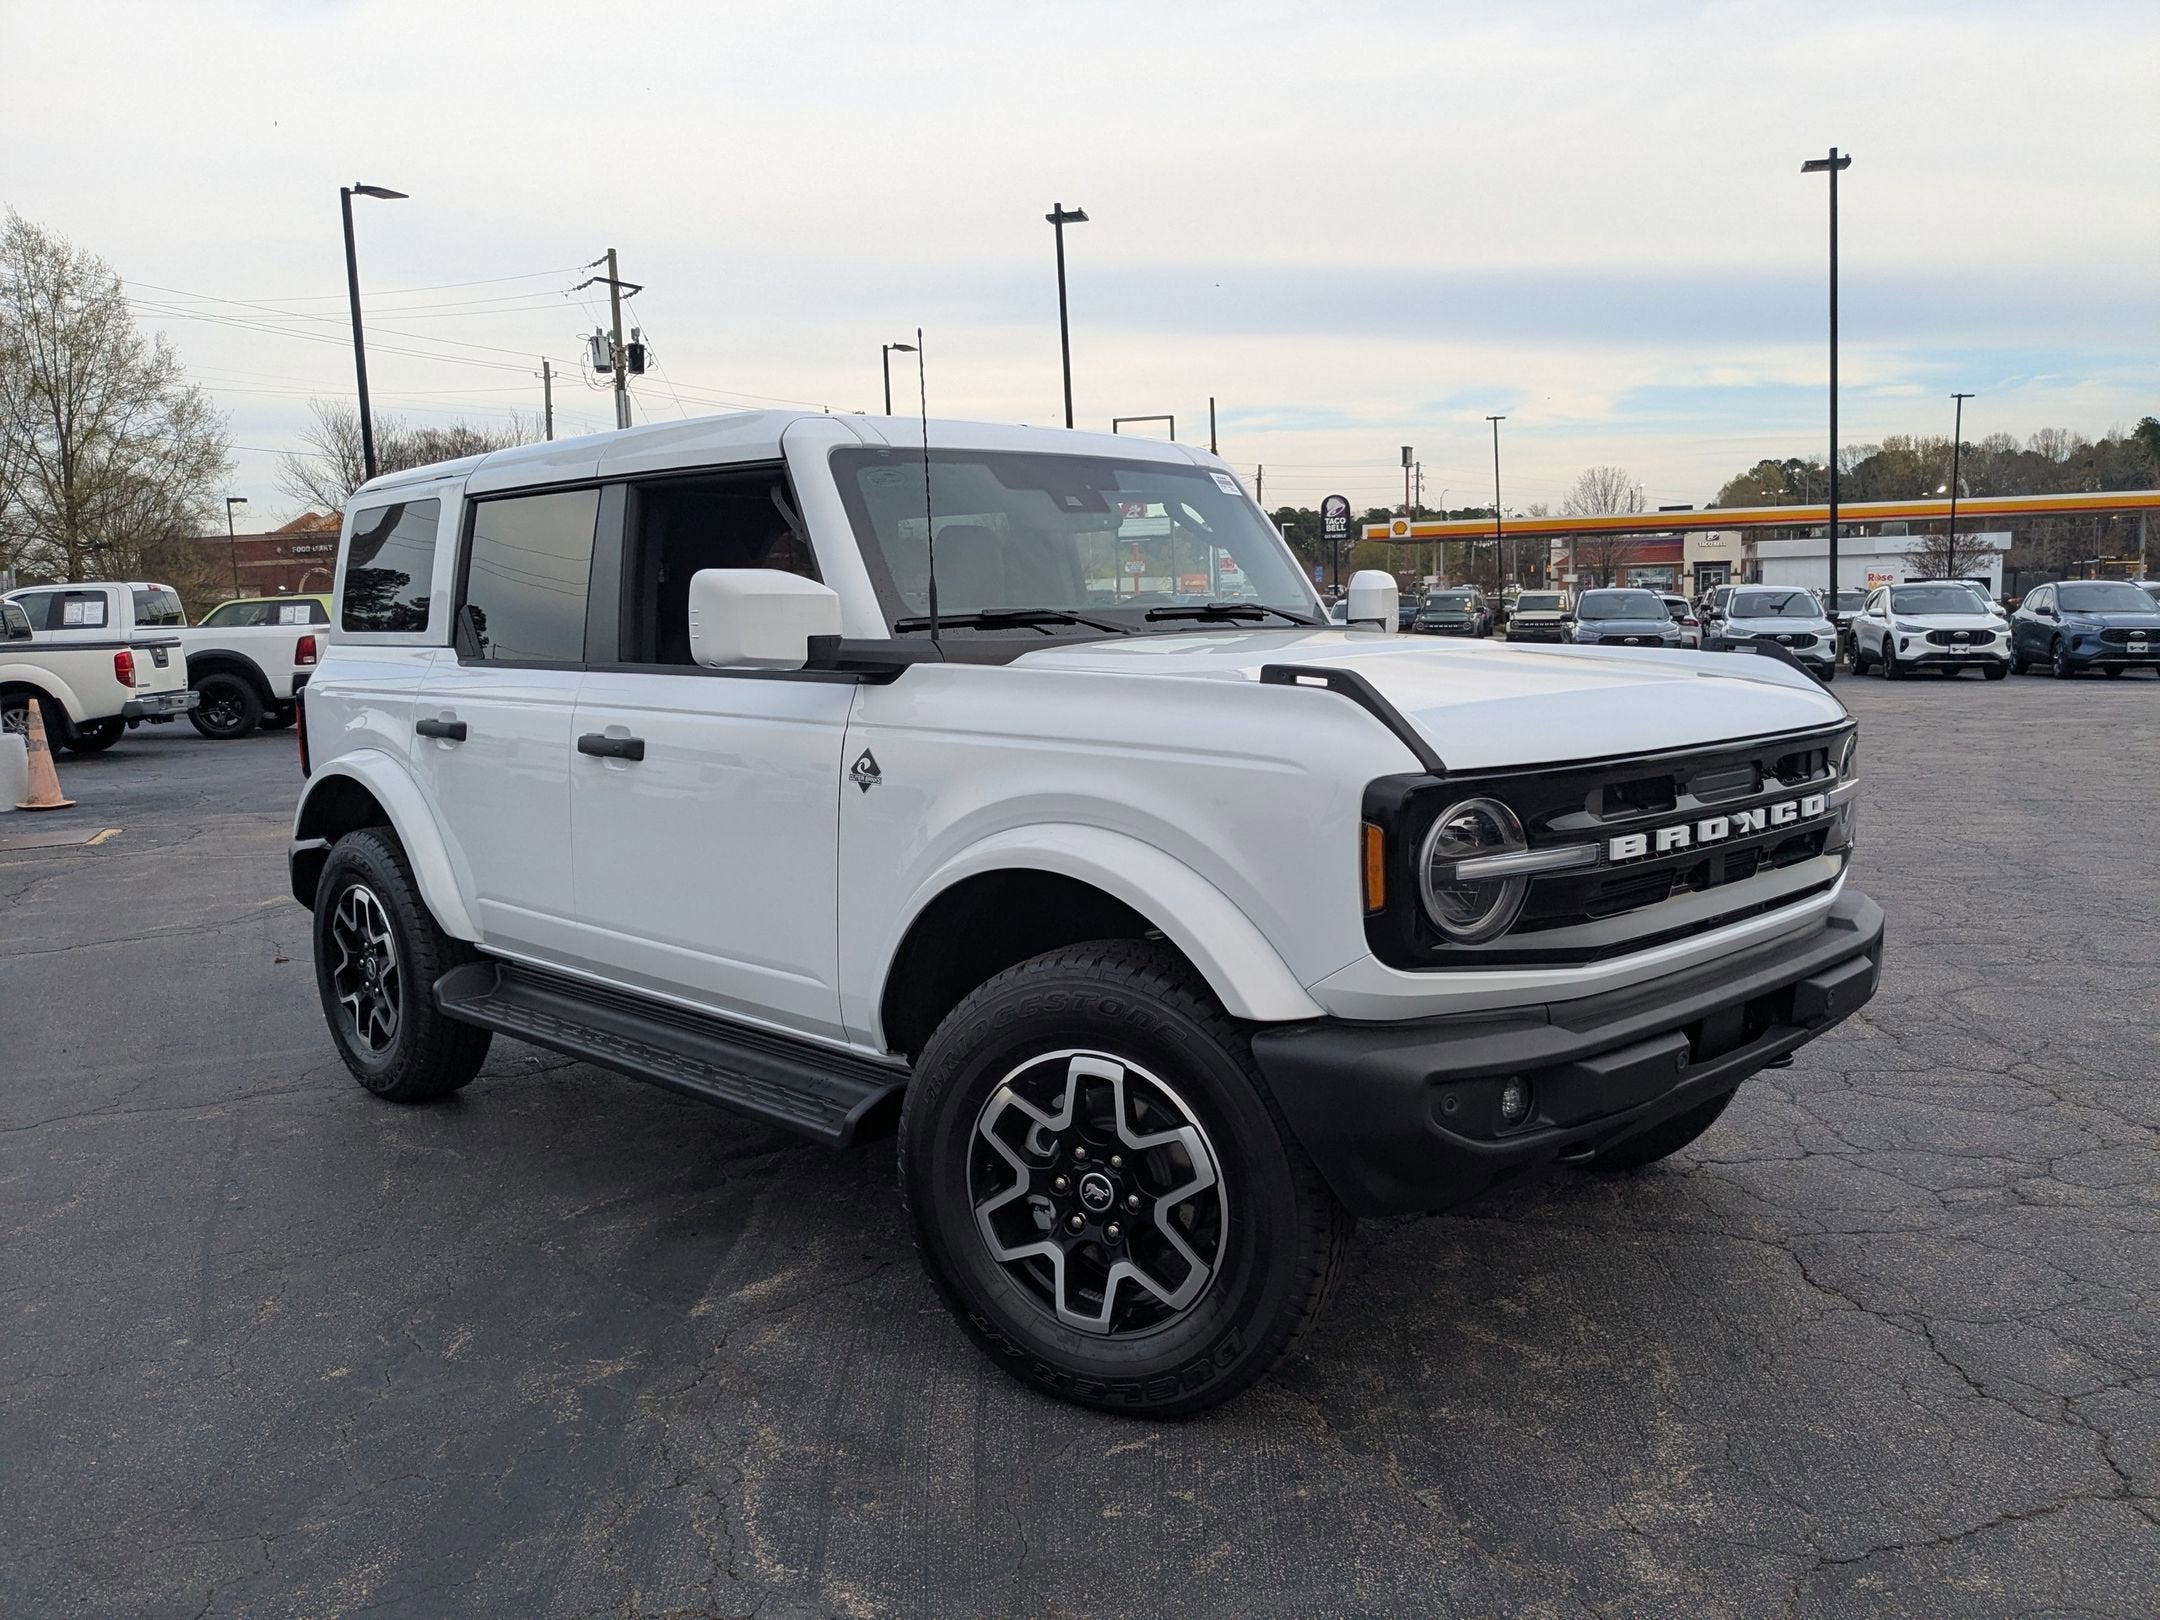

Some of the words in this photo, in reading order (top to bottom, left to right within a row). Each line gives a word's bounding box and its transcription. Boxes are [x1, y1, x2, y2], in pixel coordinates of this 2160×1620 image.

[1324, 517, 1347, 525] TACO
[1325, 524, 1347, 532] BELL
[292, 545, 311, 553] FOOD
[1609, 793, 1825, 861] BRONCO
[924, 989, 1191, 1102] BRIDGESTONE
[1031, 1325, 1248, 1405] DUELER
